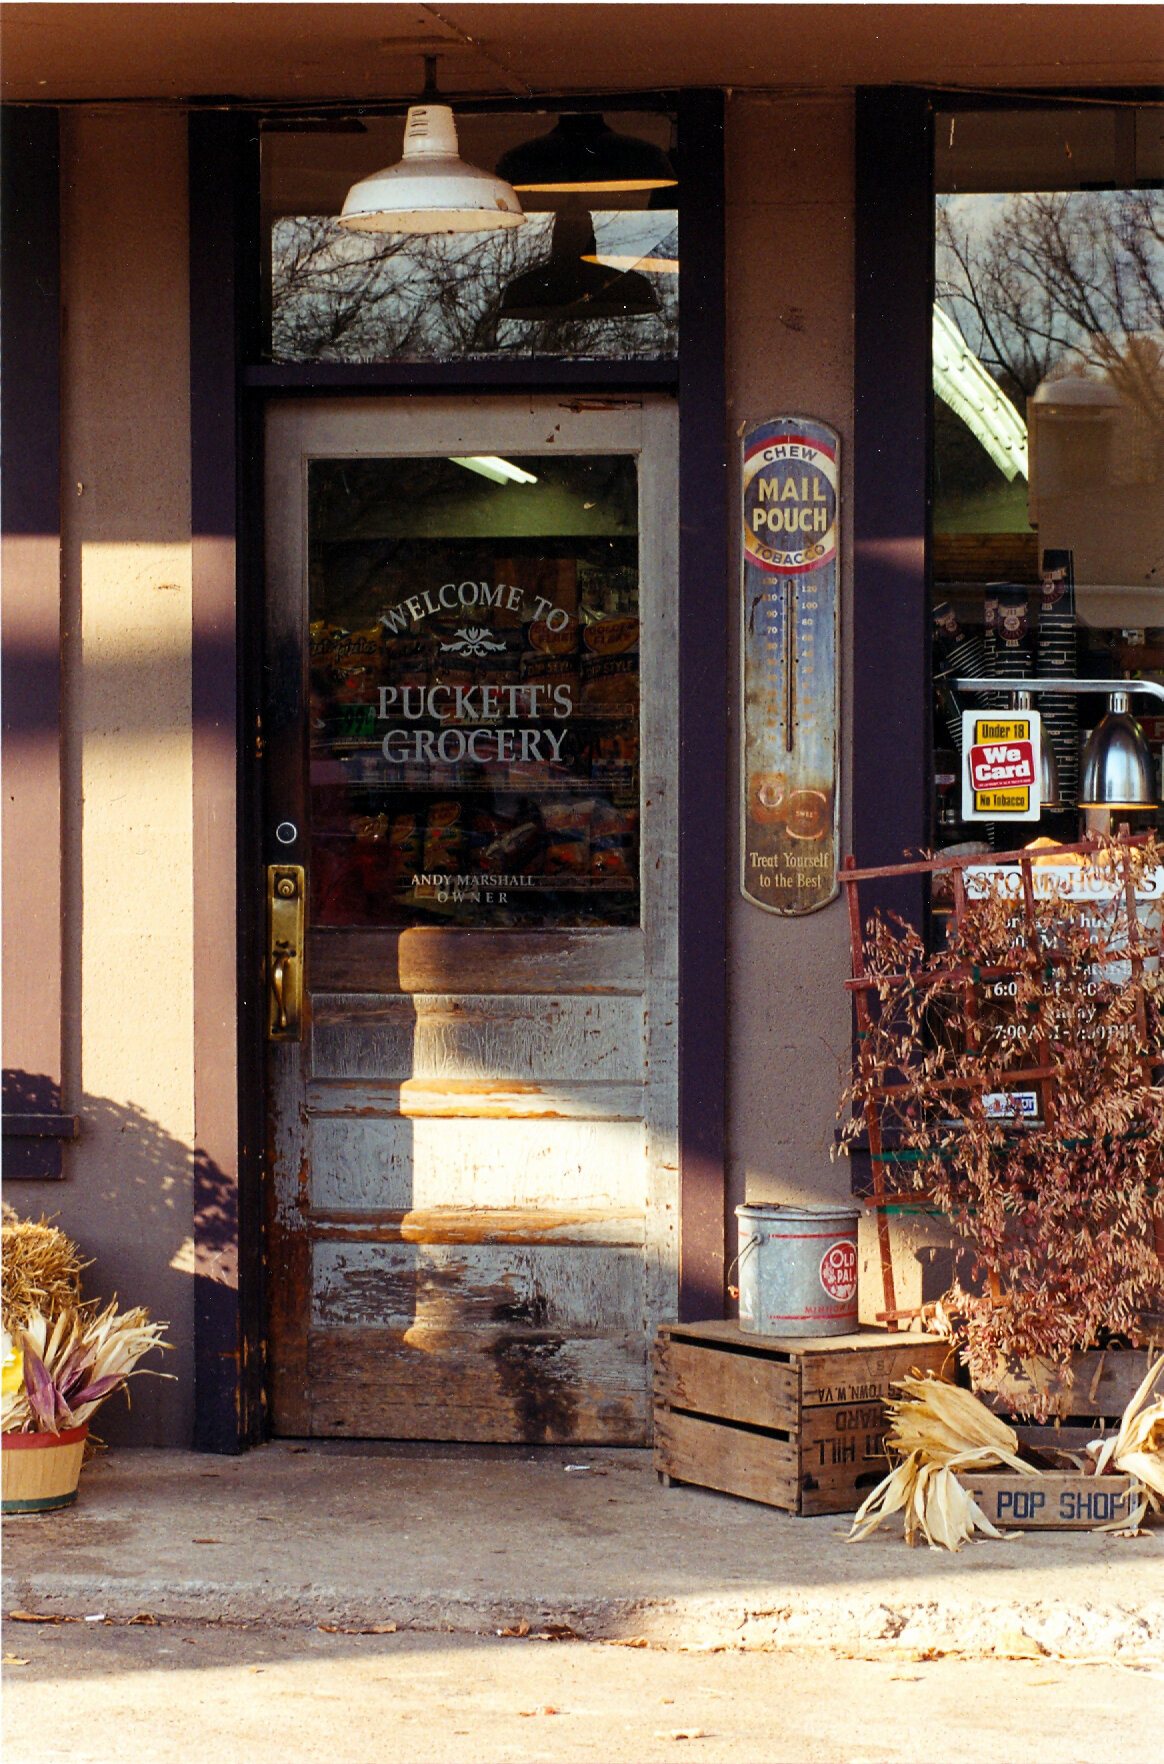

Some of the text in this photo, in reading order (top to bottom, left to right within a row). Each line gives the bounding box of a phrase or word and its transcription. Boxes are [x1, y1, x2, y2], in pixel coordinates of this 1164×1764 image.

[763, 446, 818, 462] CHEW
[758, 477, 827, 502] MAIL
[752, 507, 827, 533] POUCH
[754, 543, 826, 566] TOBACCO
[378, 580, 570, 636] WELCOME TO
[801, 602, 818, 610] 100
[767, 626, 778, 634] 70
[377, 683, 573, 721] PUCKETT'S
[981, 723, 1025, 739] Under 18
[382, 728, 569, 764] GROCERY
[983, 745, 1022, 764] We
[975, 759, 1031, 782] Card
[979, 795, 1026, 808] No Tobacco
[749, 852, 830, 868] Treat Yourself
[411, 874, 536, 887] ANDY MARSHALL
[759, 873, 822, 888] to the Best
[1067, 871, 1157, 893] HOS
[436, 891, 508, 904] OWNER
[830, 1249, 855, 1269] OLD
[837, 1268, 853, 1284] PAL
[849, 1382, 883, 1400] TOWN,
[836, 1405, 890, 1431] HARD
[813, 1436, 856, 1466] HILL
[996, 1491, 1045, 1519] POP
[1059, 1491, 1126, 1520] SHOP
